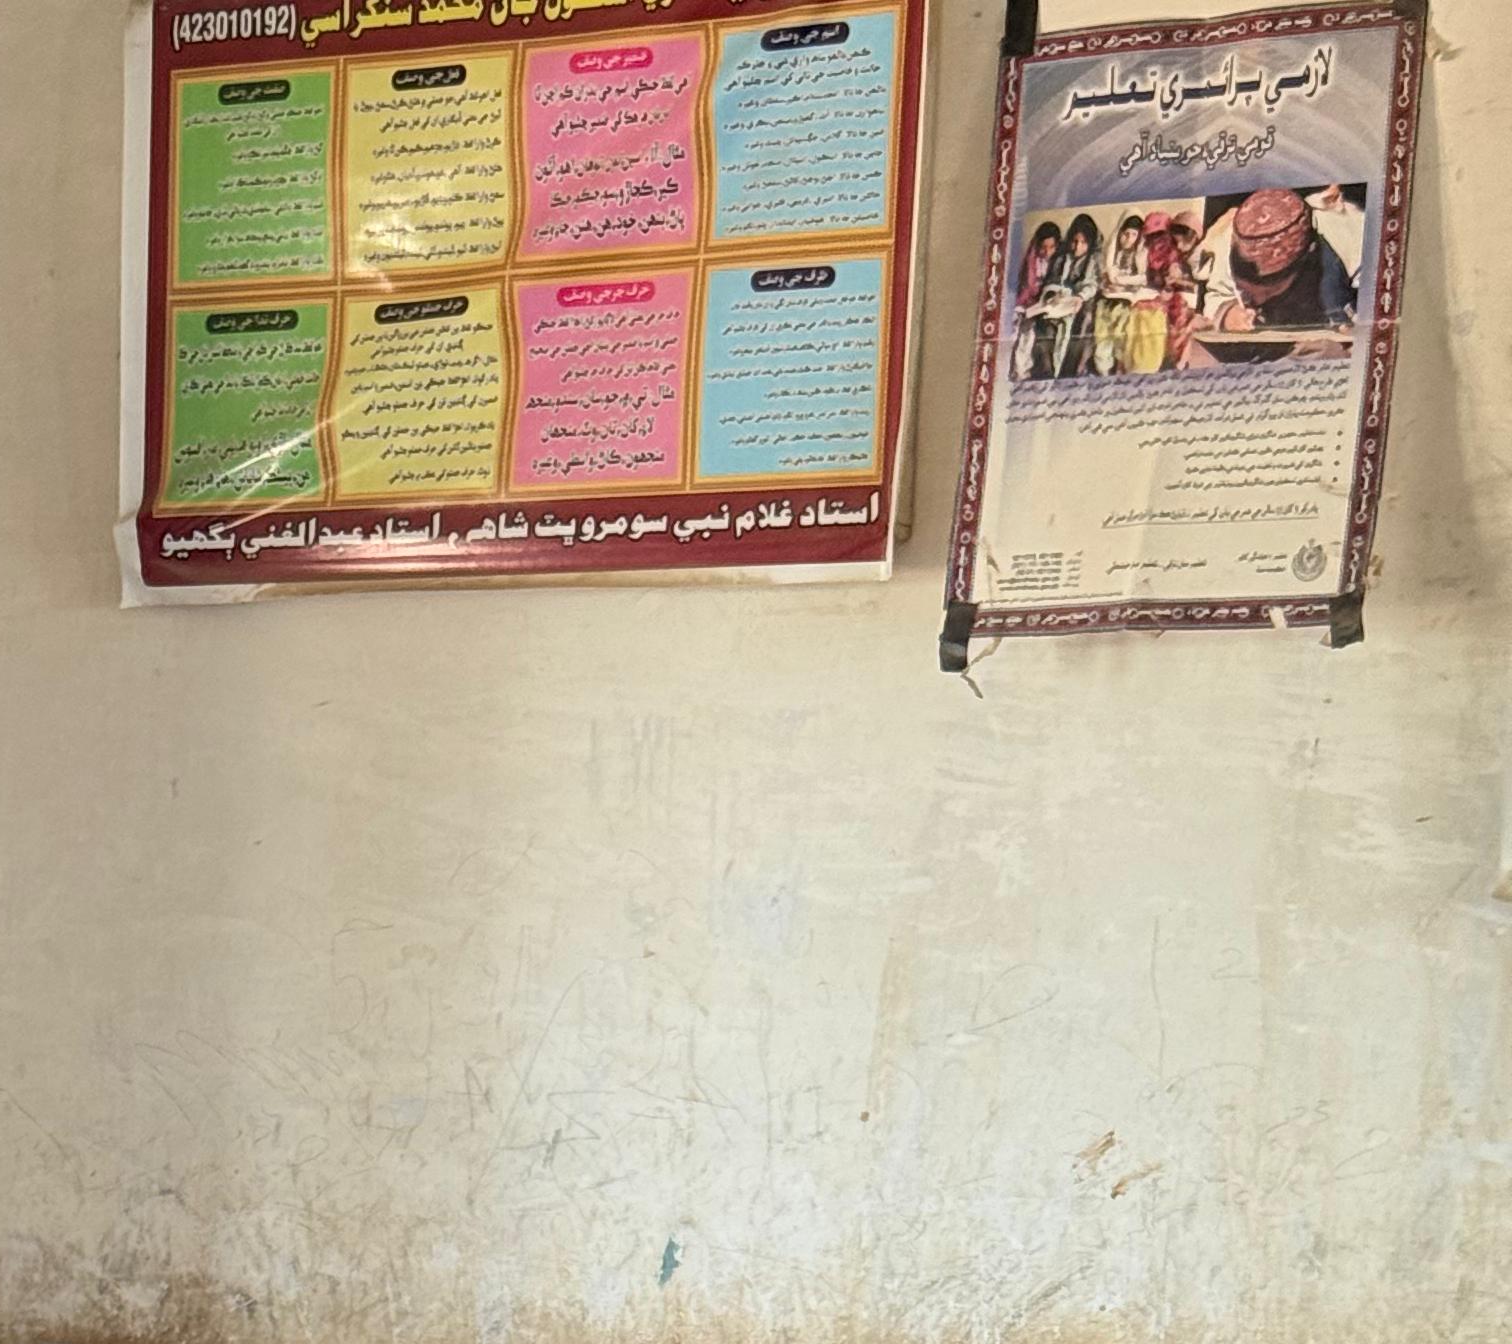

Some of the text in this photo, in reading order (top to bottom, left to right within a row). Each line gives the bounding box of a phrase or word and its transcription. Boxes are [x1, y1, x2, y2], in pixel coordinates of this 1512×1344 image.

[172, 4, 296, 50] (423010192)
[1062, 46, 1333, 120] لازمي پرائمري تعليم
[1119, 129, 1149, 176] آهي
[1236, 125, 1276, 167] قومي
[370, 511, 441, 545] استاد
[581, 511, 667, 542] سومرو
[674, 503, 729, 543] نبي
[735, 499, 792, 537] غلام
[799, 491, 879, 527] استاد
